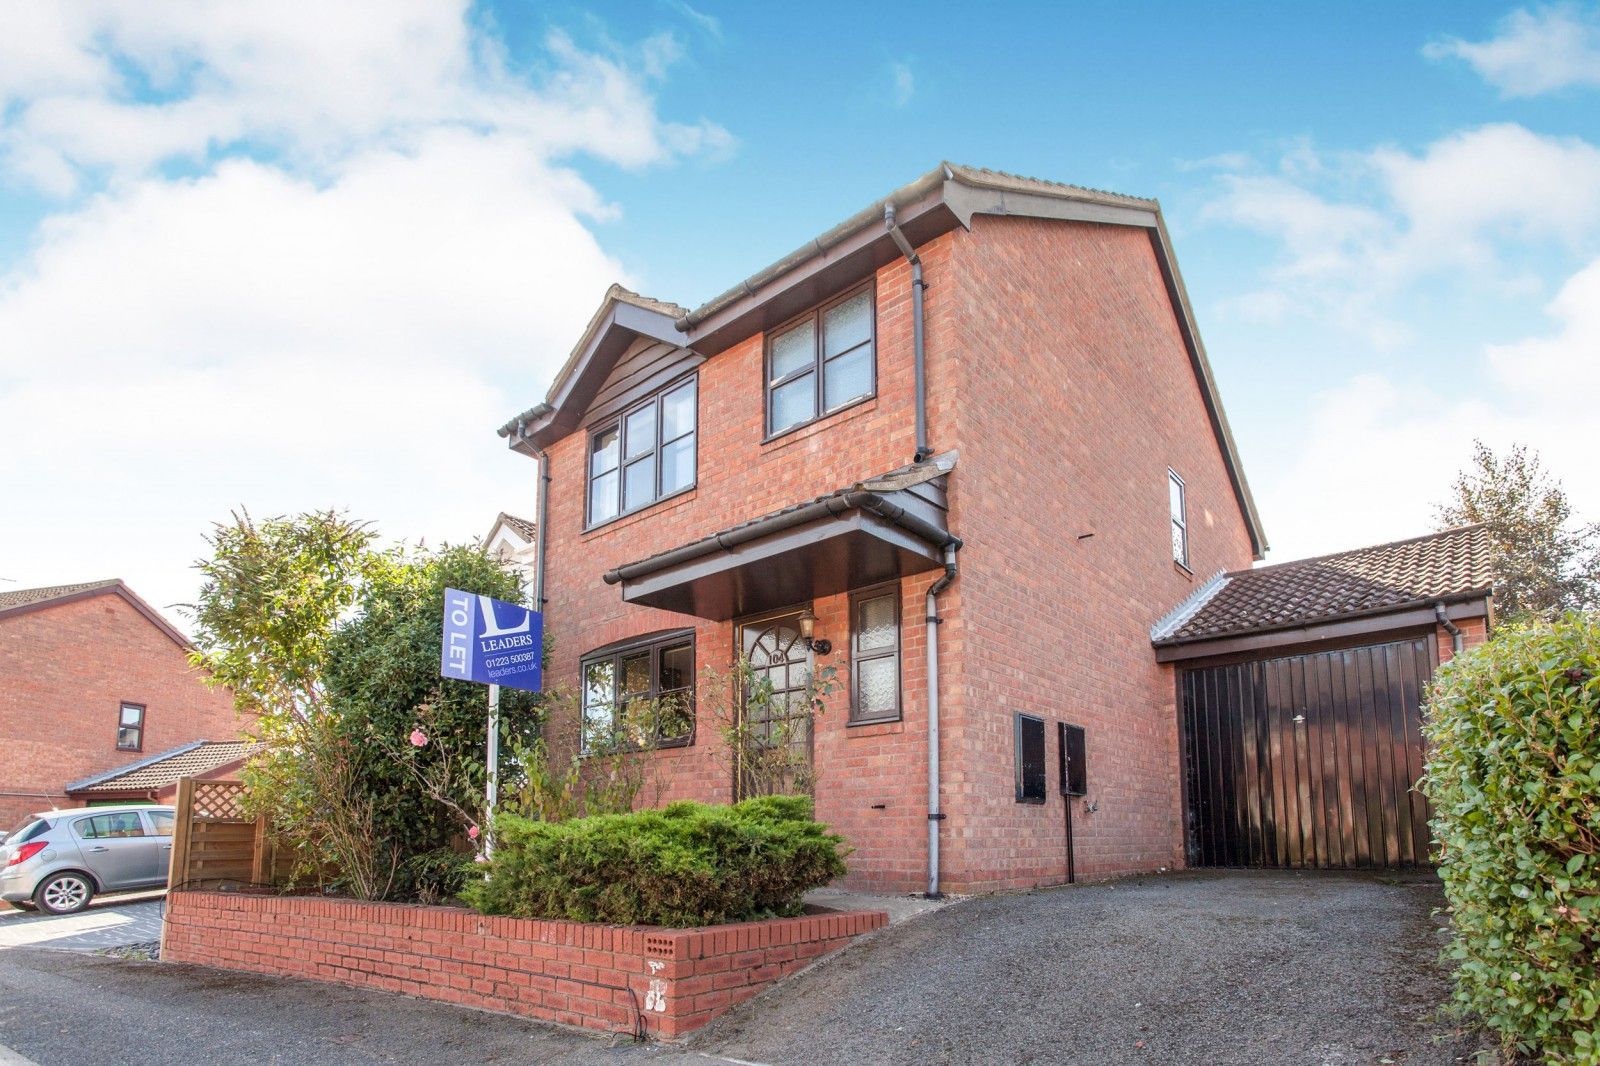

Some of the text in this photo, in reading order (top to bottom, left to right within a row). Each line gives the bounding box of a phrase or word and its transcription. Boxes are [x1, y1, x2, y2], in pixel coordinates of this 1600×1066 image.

[479, 595, 530, 638] L
[449, 598, 469, 674] TO LET
[481, 634, 533, 652] LEADERS
[485, 656, 510, 668] 01223
[769, 653, 784, 665] 104
[487, 661, 538, 678] leaders.co.uk
